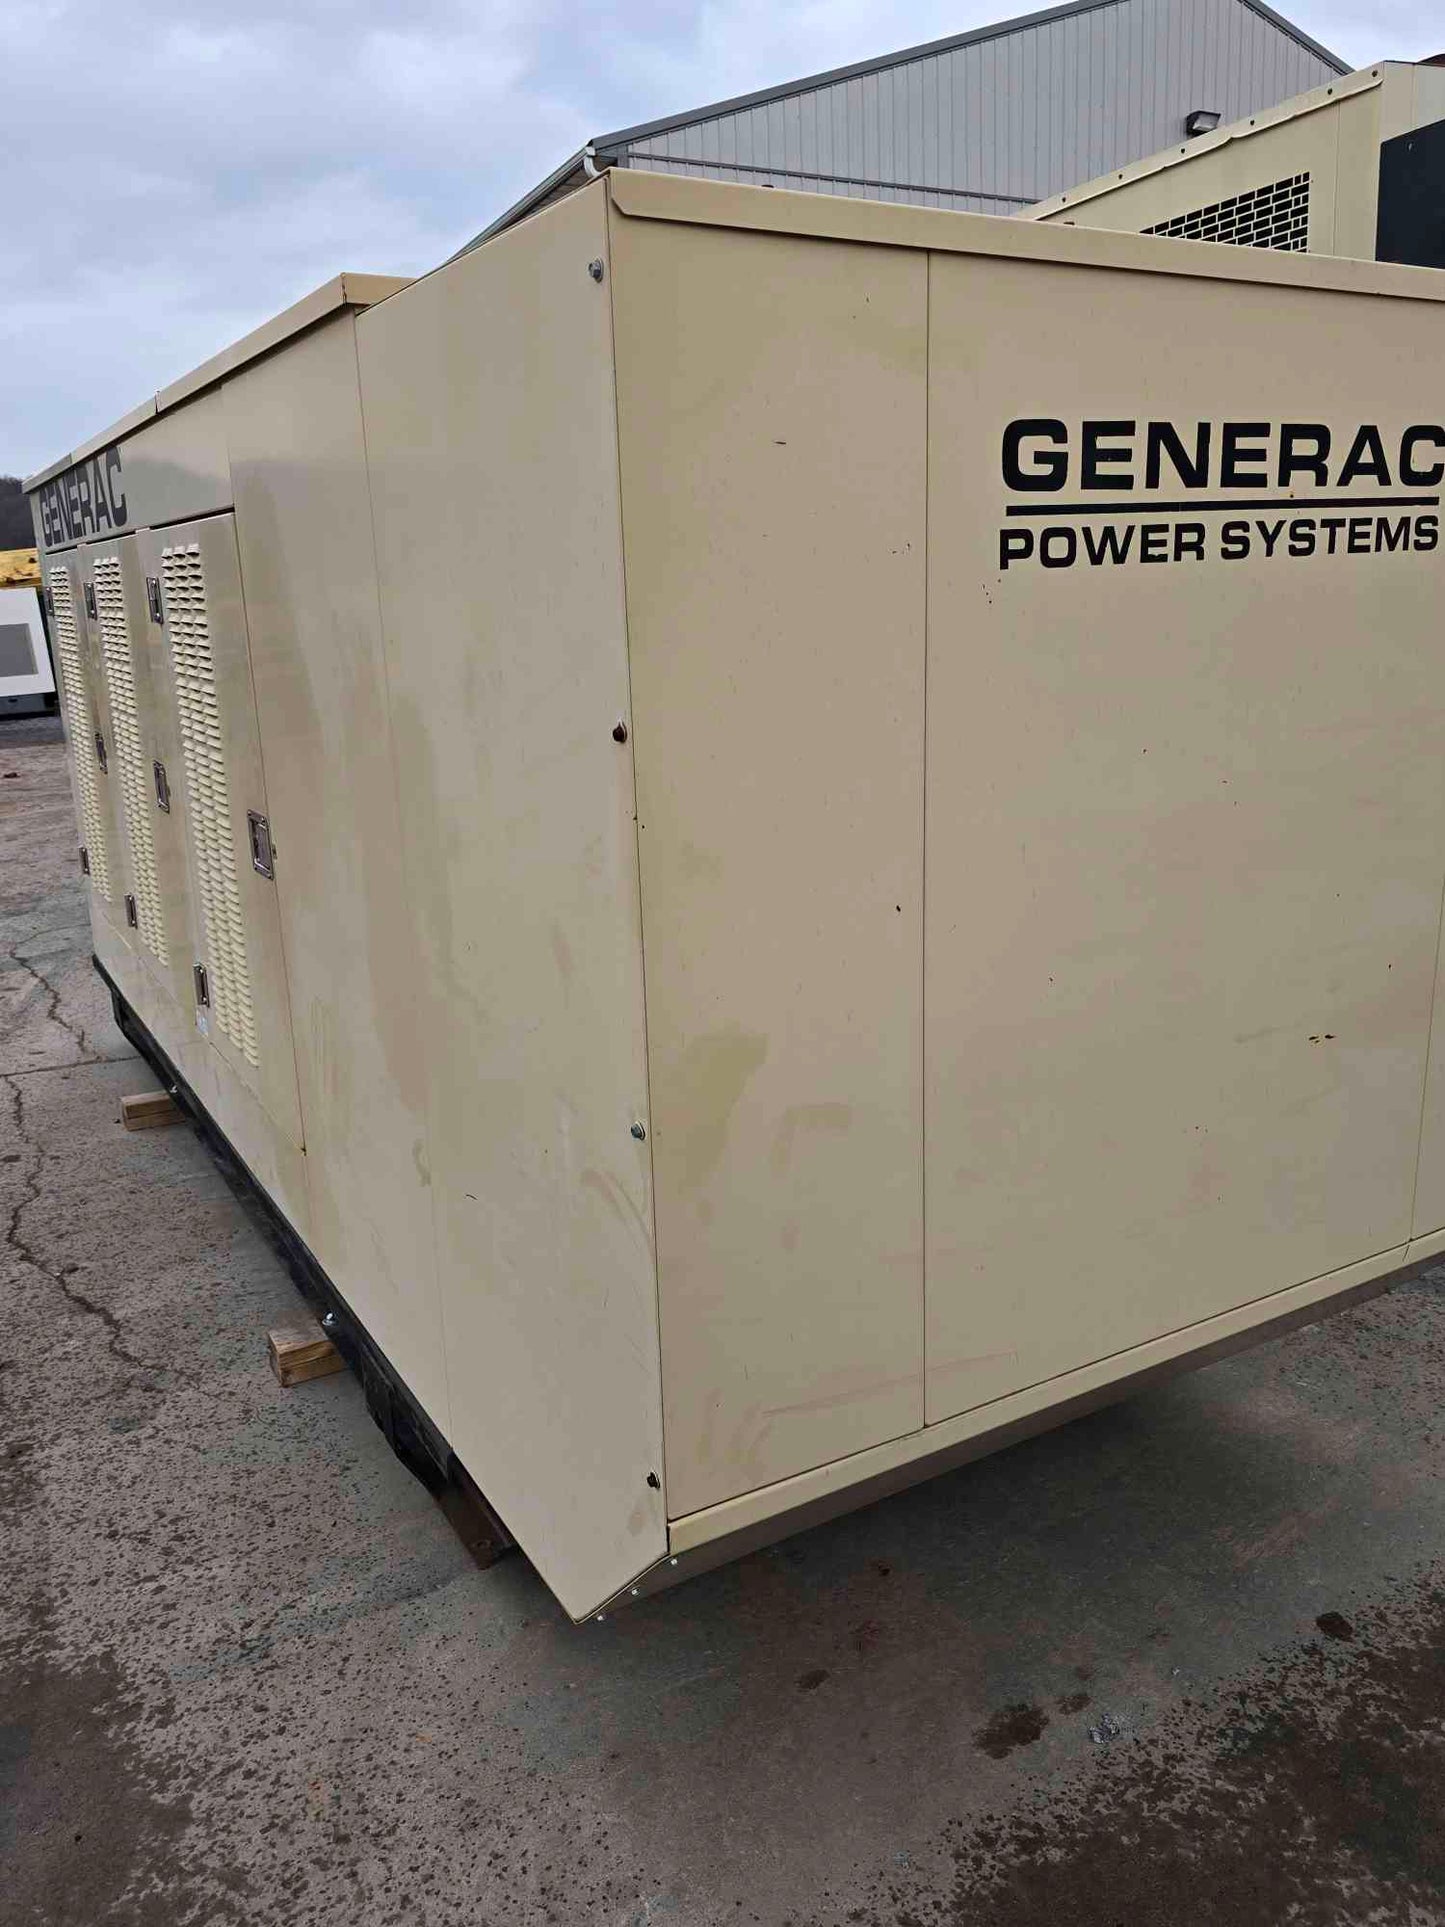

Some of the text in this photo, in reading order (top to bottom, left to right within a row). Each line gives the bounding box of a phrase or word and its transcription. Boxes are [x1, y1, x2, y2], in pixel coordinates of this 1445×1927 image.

[1002, 418, 1445, 492] GENERAC
[39, 446, 127, 548] GENERAC
[1000, 515, 1439, 570] POWER SYSTEMS
